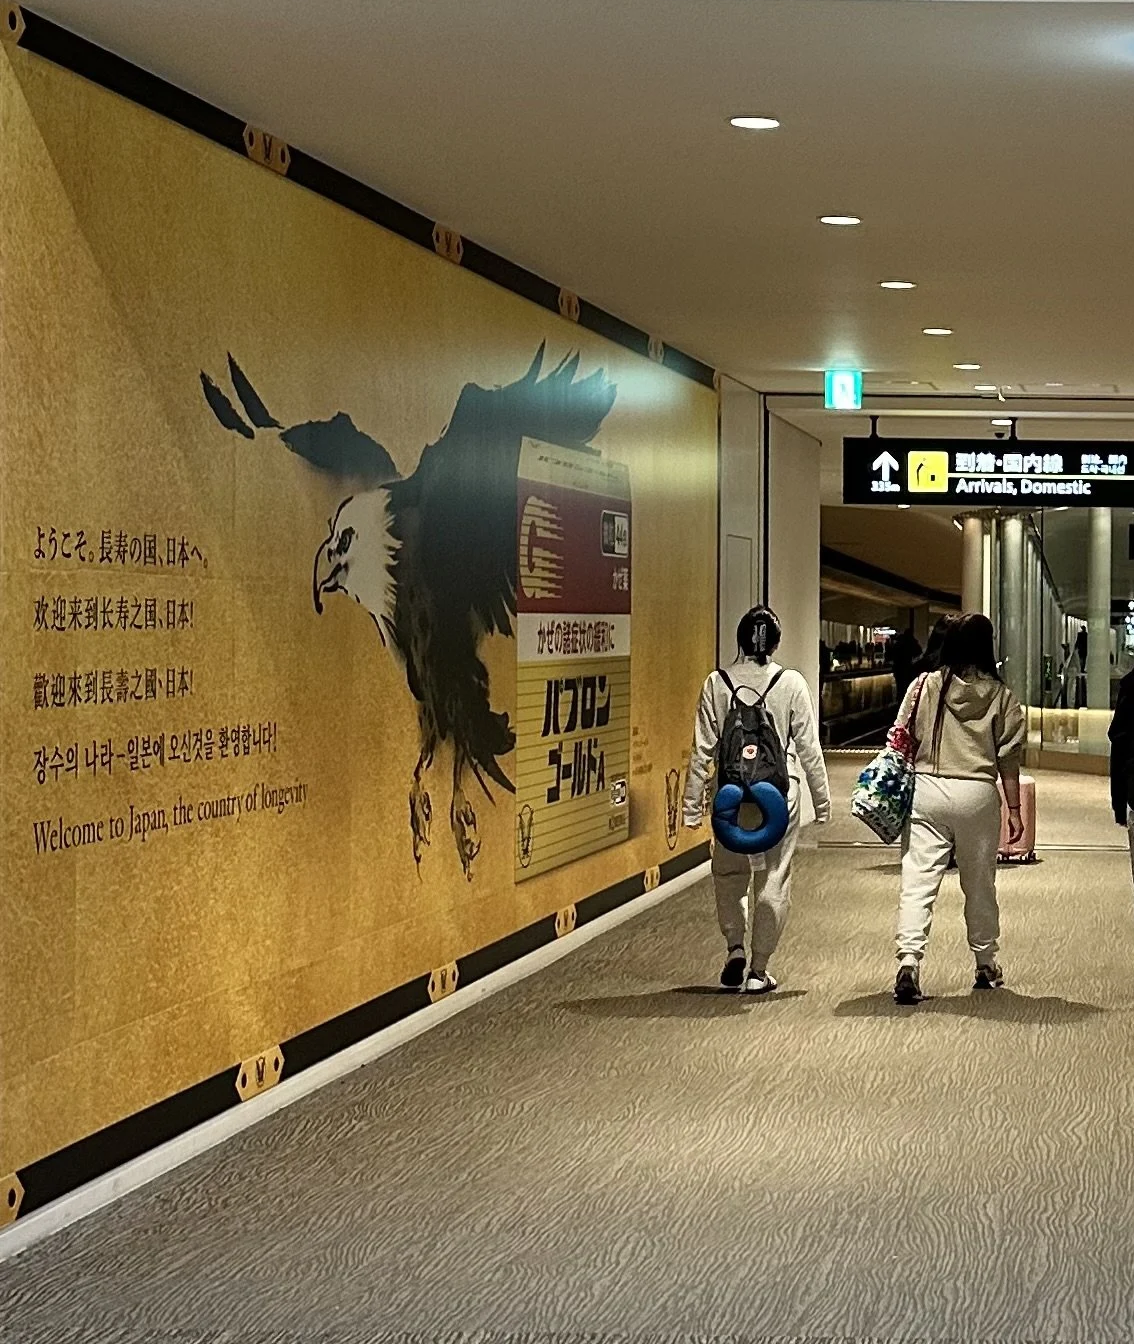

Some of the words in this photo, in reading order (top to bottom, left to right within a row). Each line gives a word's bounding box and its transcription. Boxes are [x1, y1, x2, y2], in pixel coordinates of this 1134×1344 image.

[955, 477, 1018, 496] Arrivals,
[1020, 478, 1092, 495] Domestic
[541, 675, 612, 738] パブロン
[33, 742, 79, 785] 장수의
[168, 727, 215, 764] 오신것을
[218, 721, 278, 759] 환영합니다!
[33, 817, 104, 855] Welcome
[109, 816, 125, 839] to
[127, 805, 169, 843] Japan,
[173, 796, 194, 826] the
[197, 793, 243, 823] country
[245, 783, 260, 812] of
[261, 777, 308, 815] longevity
